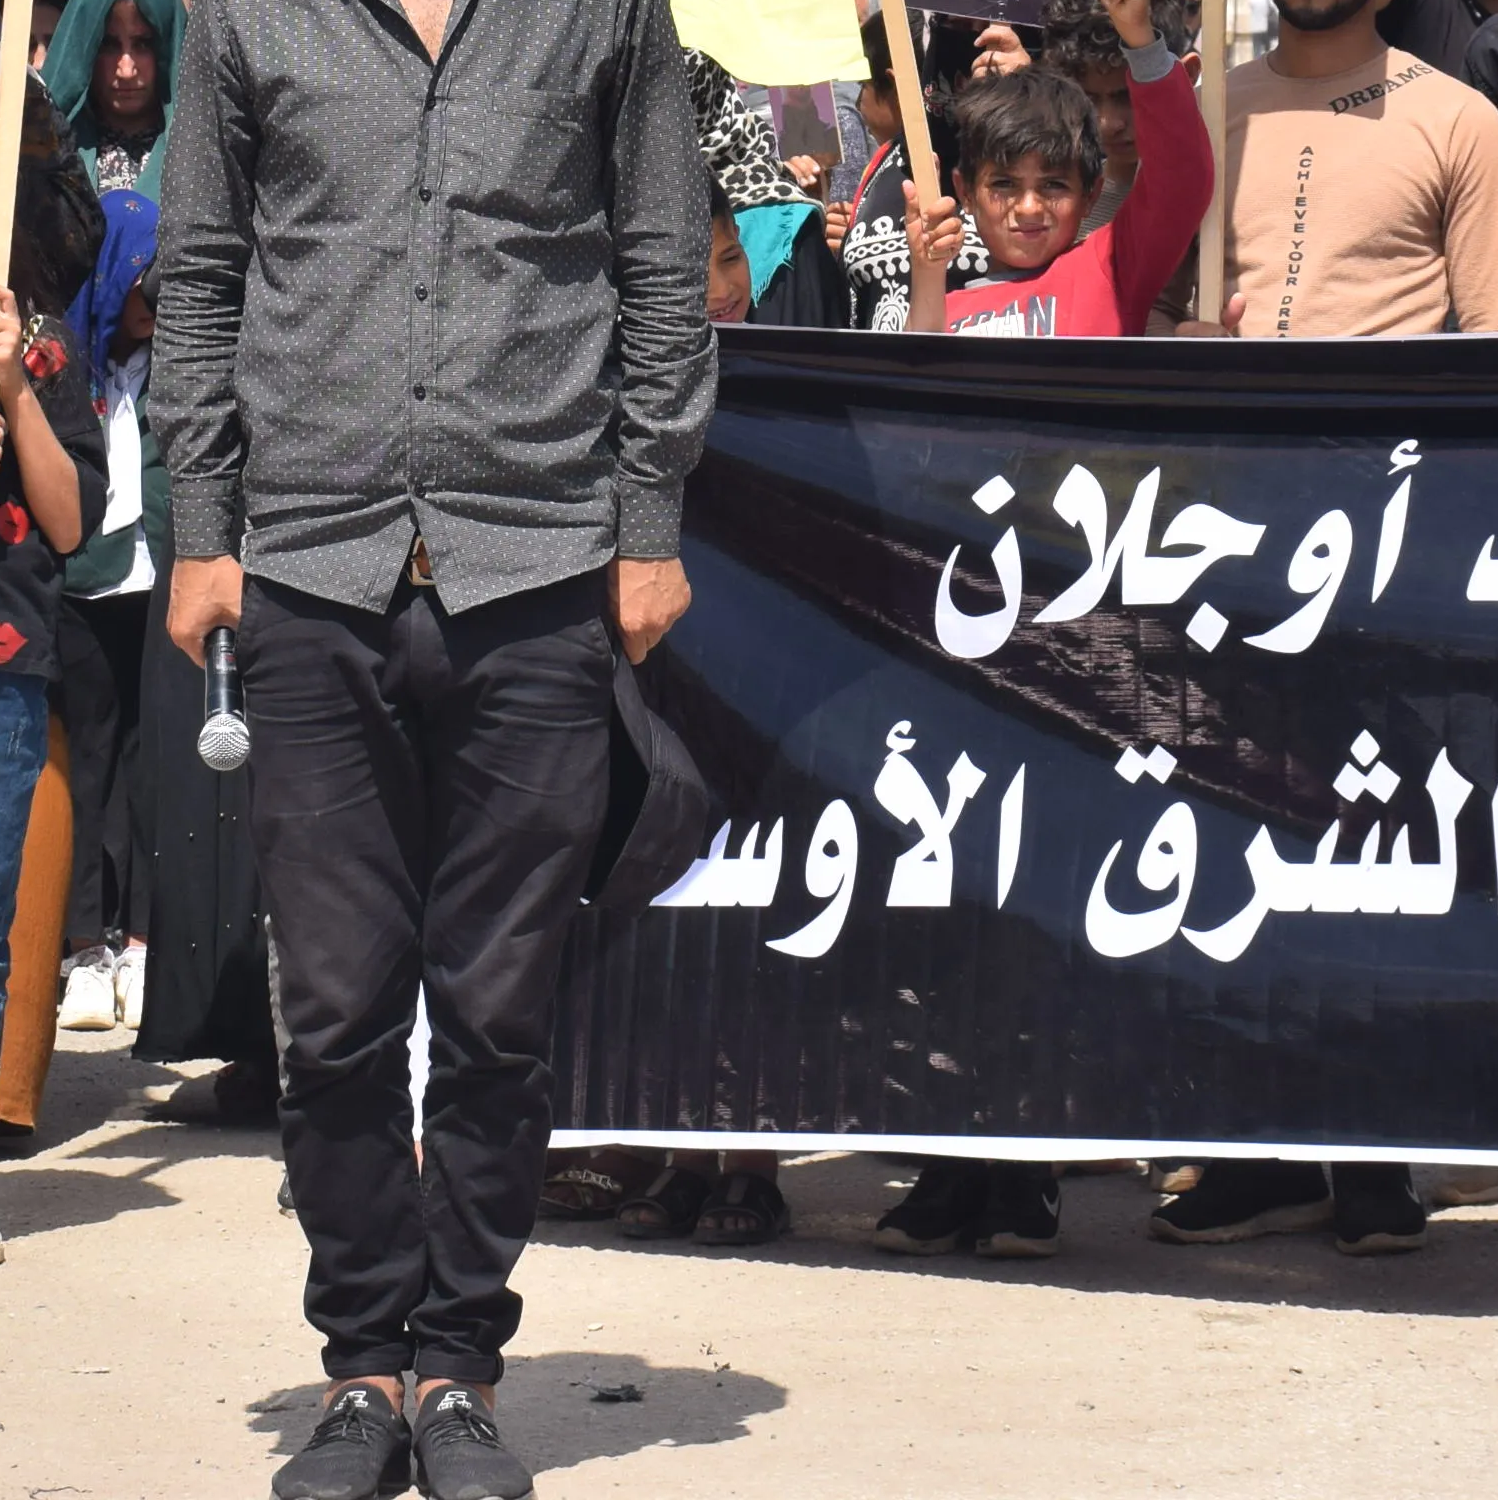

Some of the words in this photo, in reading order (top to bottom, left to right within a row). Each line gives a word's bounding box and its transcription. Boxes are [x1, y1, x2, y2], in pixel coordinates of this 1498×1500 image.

[1329, 63, 1433, 116] DREAMS
[1293, 145, 1314, 233] ACHIEVE
[1285, 239, 1304, 287] YOUR
[1277, 295, 1293, 338] DRE
[934, 438, 1423, 660] أوجلان
[647, 719, 1026, 959] الأوس
